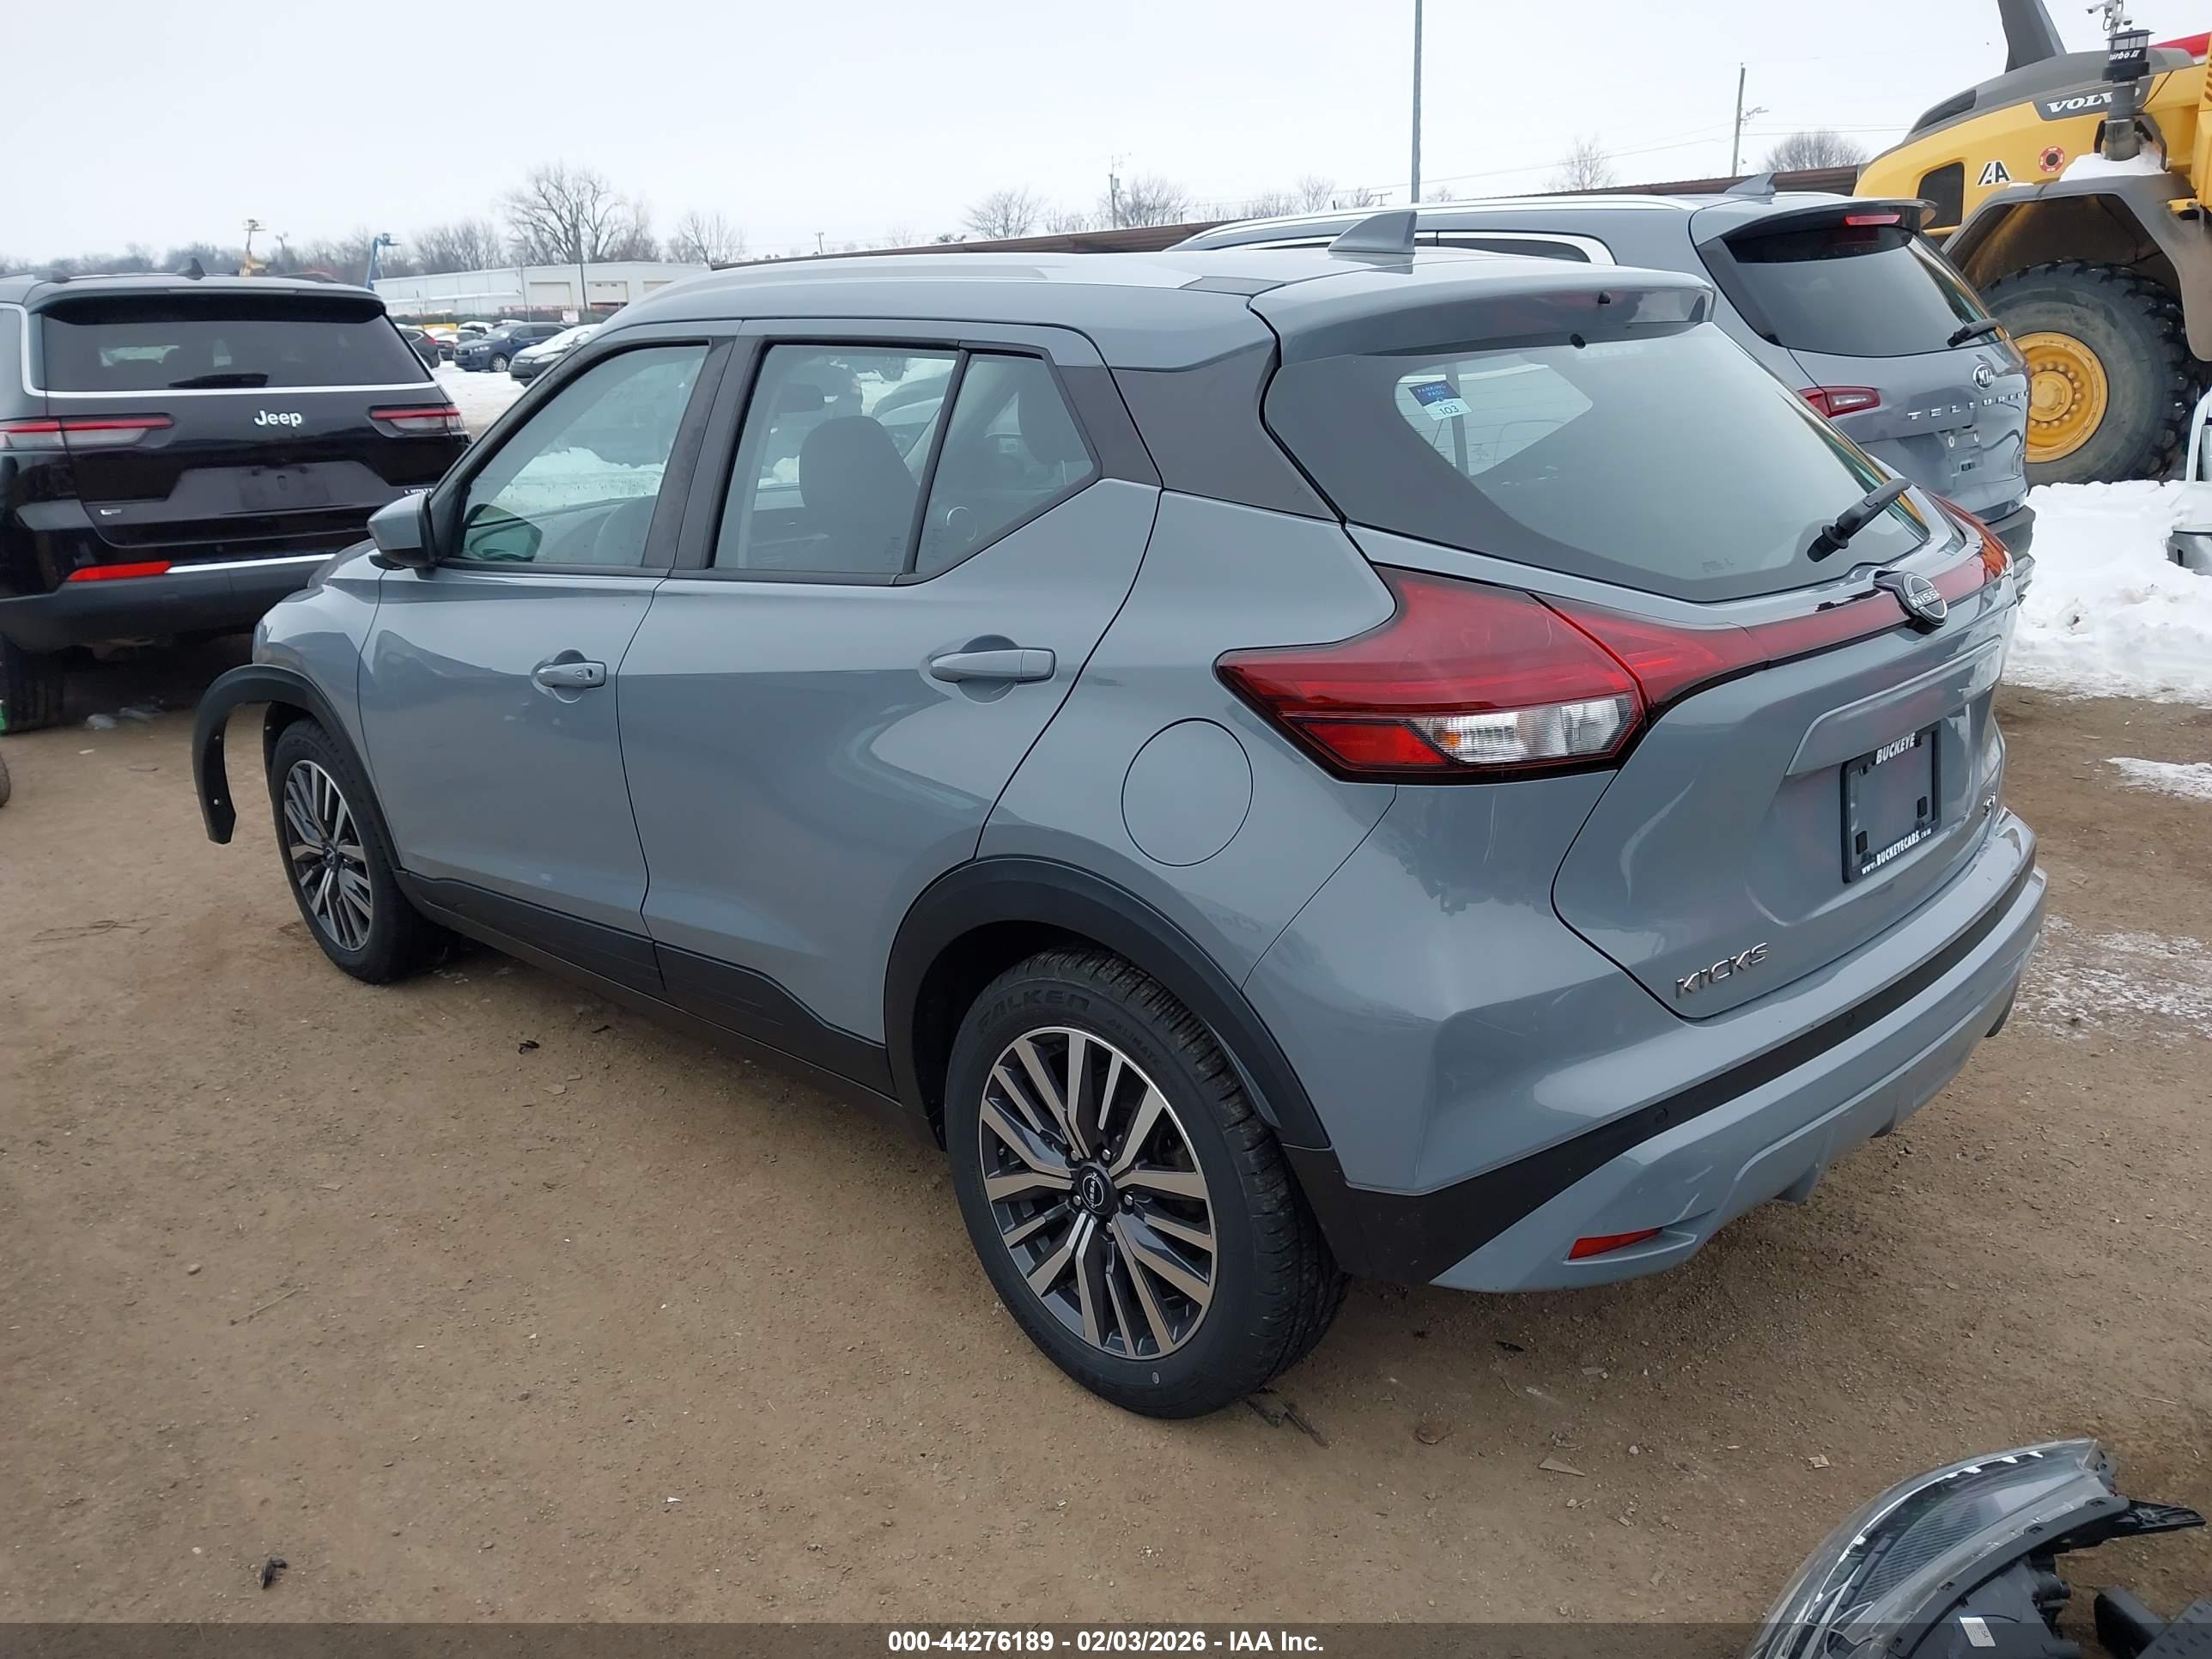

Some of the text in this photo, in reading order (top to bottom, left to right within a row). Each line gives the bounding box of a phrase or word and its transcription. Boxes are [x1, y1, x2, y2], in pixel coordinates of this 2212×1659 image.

[253, 410, 302, 428] Jeep
[1438, 404, 1460, 416] 103
[1875, 731, 1916, 765] BUCKEYE
[1675, 942, 1769, 999] KICKS
